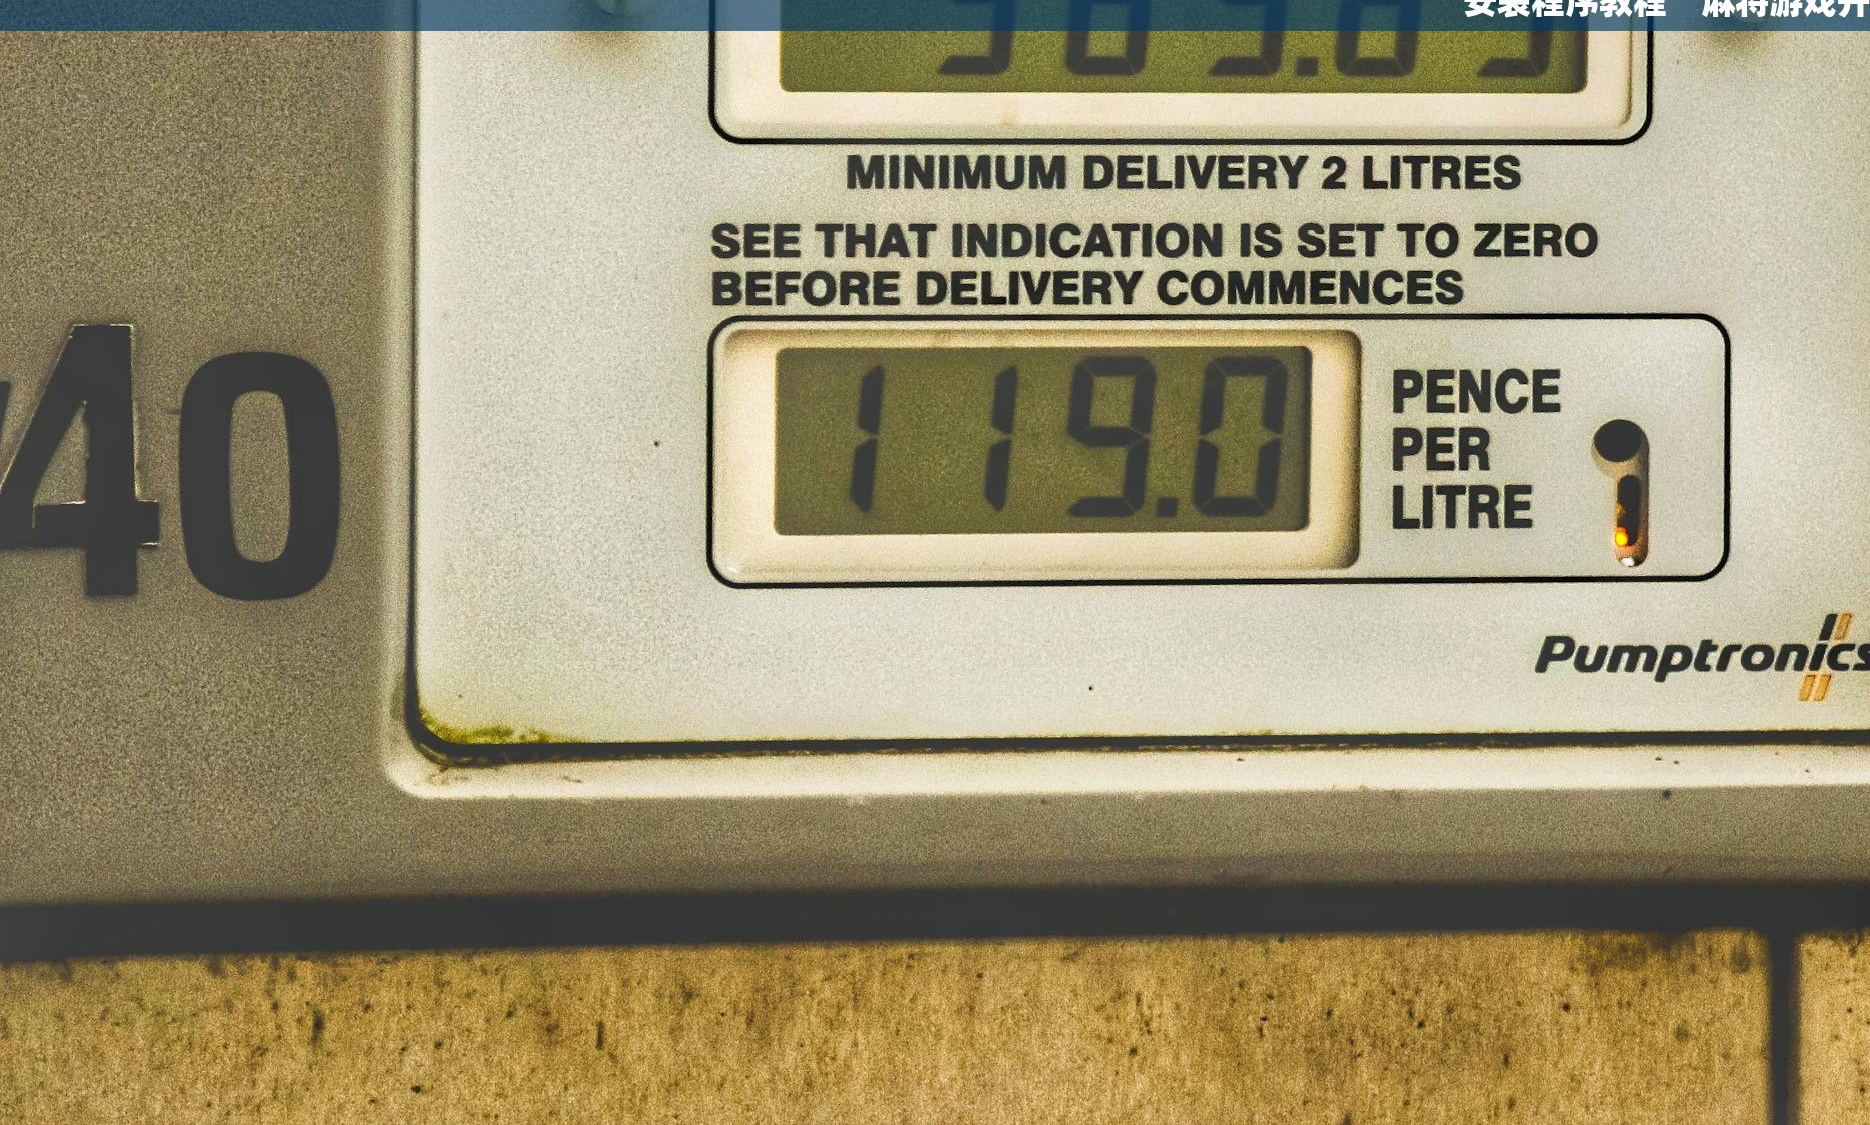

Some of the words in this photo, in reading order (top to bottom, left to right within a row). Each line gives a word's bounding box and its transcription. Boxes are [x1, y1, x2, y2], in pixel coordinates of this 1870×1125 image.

[847, 154, 1066, 190] MINIMUM
[1083, 155, 1309, 190] DELIVERY
[1322, 155, 1347, 190] 2
[1363, 154, 1521, 190] LITRES
[711, 222, 801, 259] SEE
[815, 223, 937, 258] THAT
[952, 222, 1223, 259] INDICATION
[1240, 222, 1283, 259] IS
[1297, 222, 1385, 258] SET
[1396, 222, 1459, 258] TO
[1473, 222, 1598, 258] ZERO
[712, 270, 901, 307] BEFORE
[916, 270, 1144, 306] DELIVERY
[1157, 269, 1464, 306] COMMENCES
[1393, 368, 1561, 414] PENCE
[847, 354, 1293, 518] 119.0
[1392, 426, 1490, 472] PER
[1392, 484, 1533, 530] LITRE
